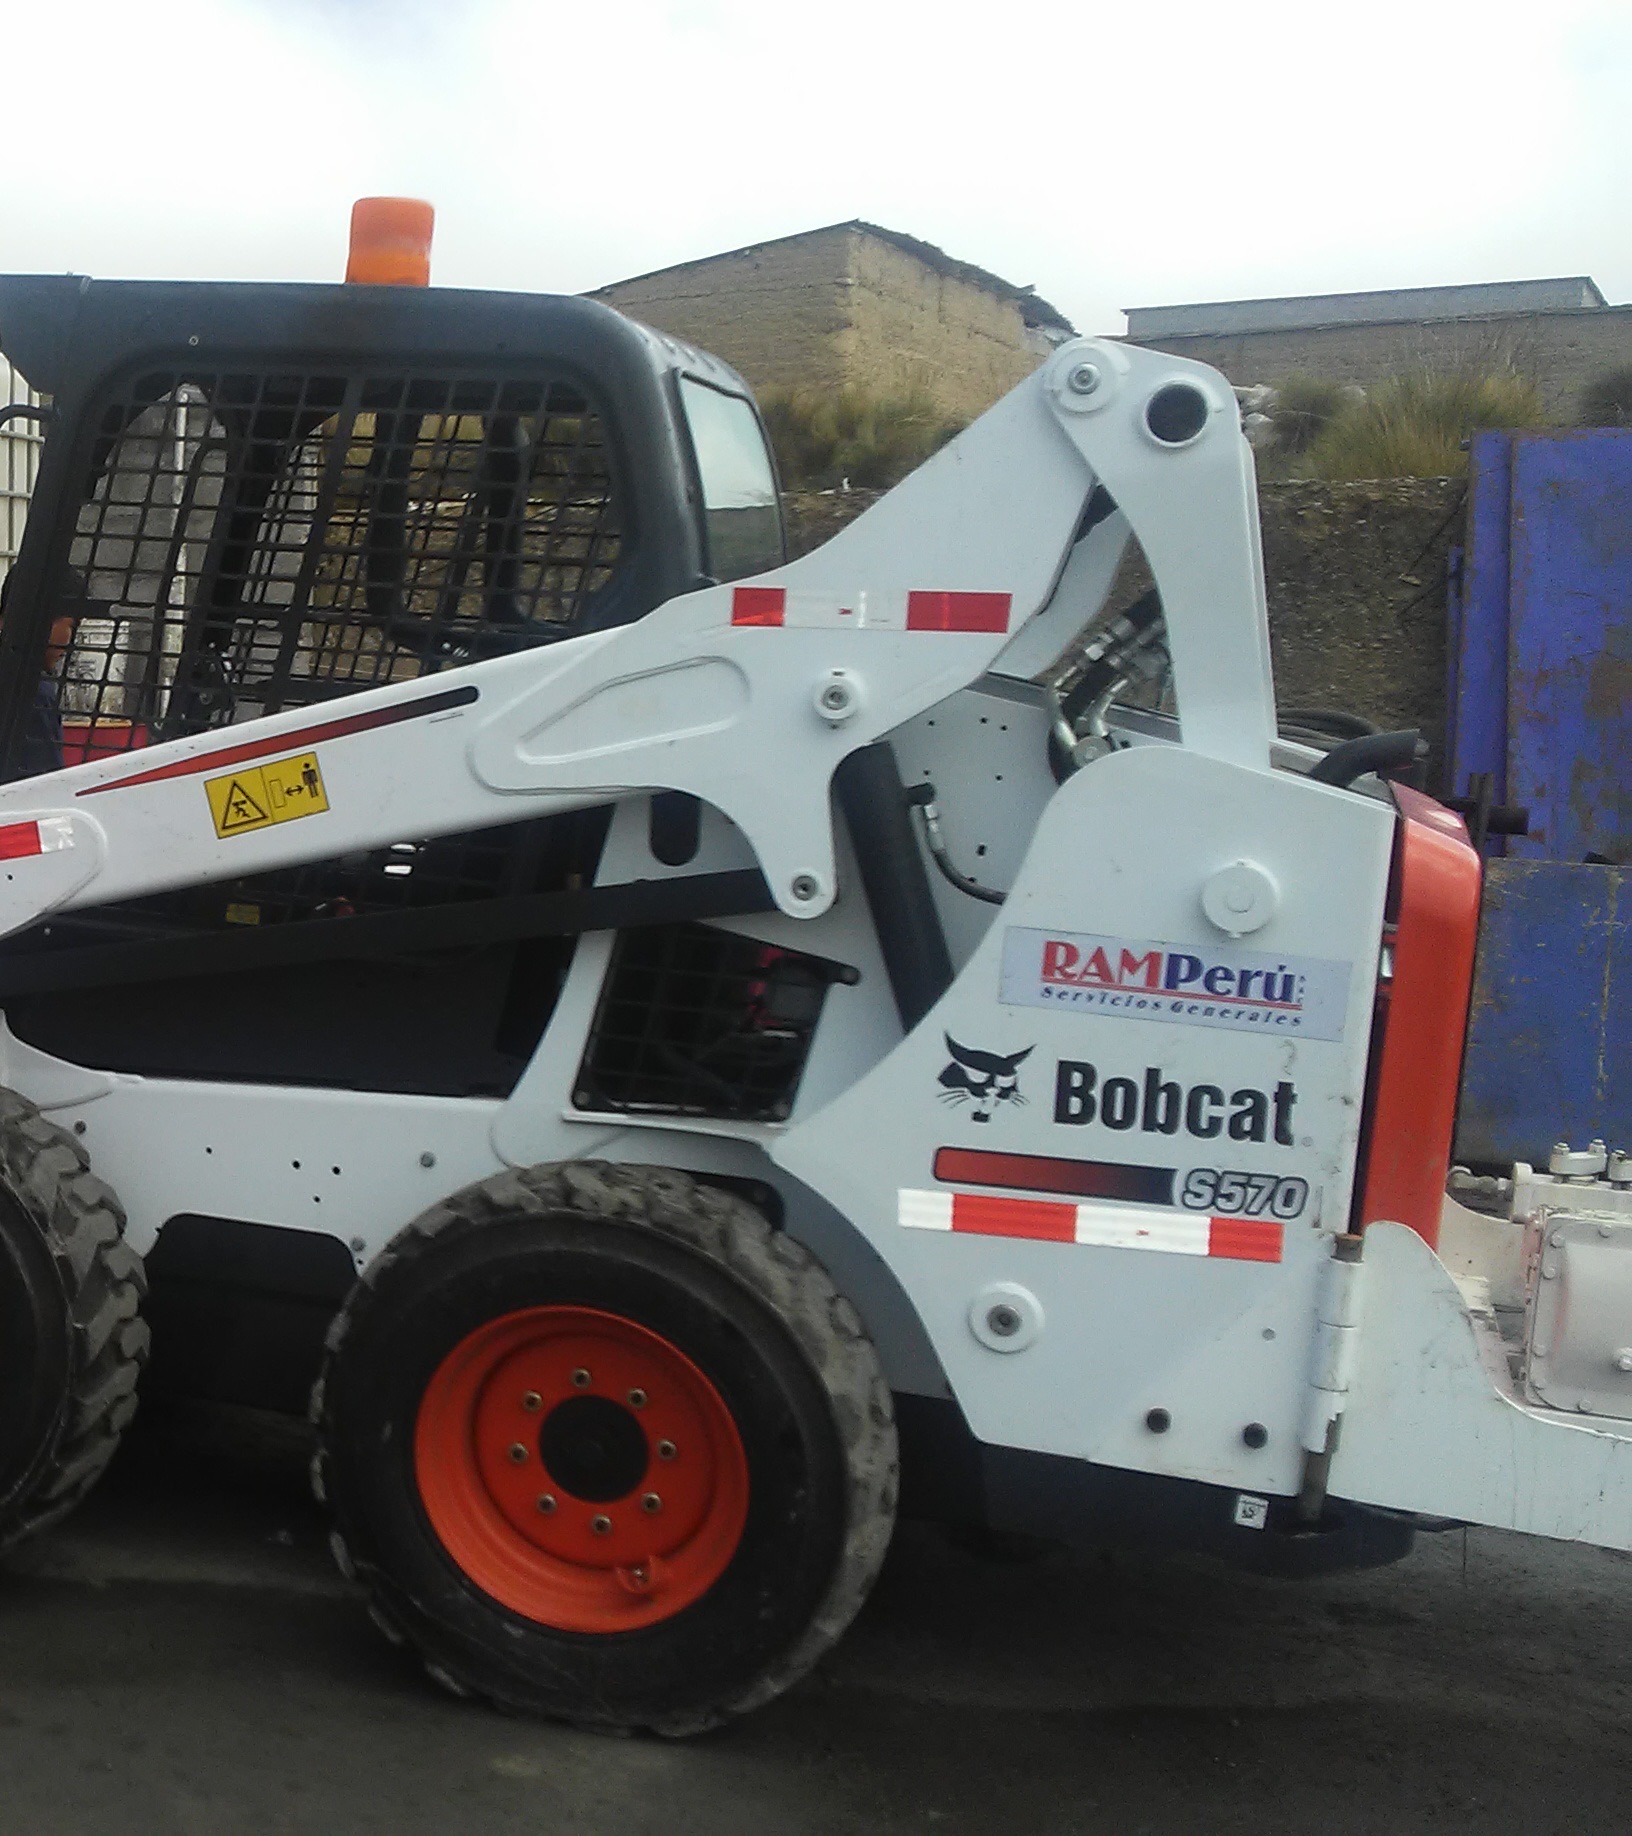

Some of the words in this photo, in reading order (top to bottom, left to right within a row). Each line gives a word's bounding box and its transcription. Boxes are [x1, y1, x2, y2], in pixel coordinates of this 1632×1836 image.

[1040, 985, 1163, 1012] Servicios
[1169, 1000, 1303, 1028] Generales
[1054, 1059, 1298, 1147] Bobcat
[1181, 1167, 1310, 1220] S570
